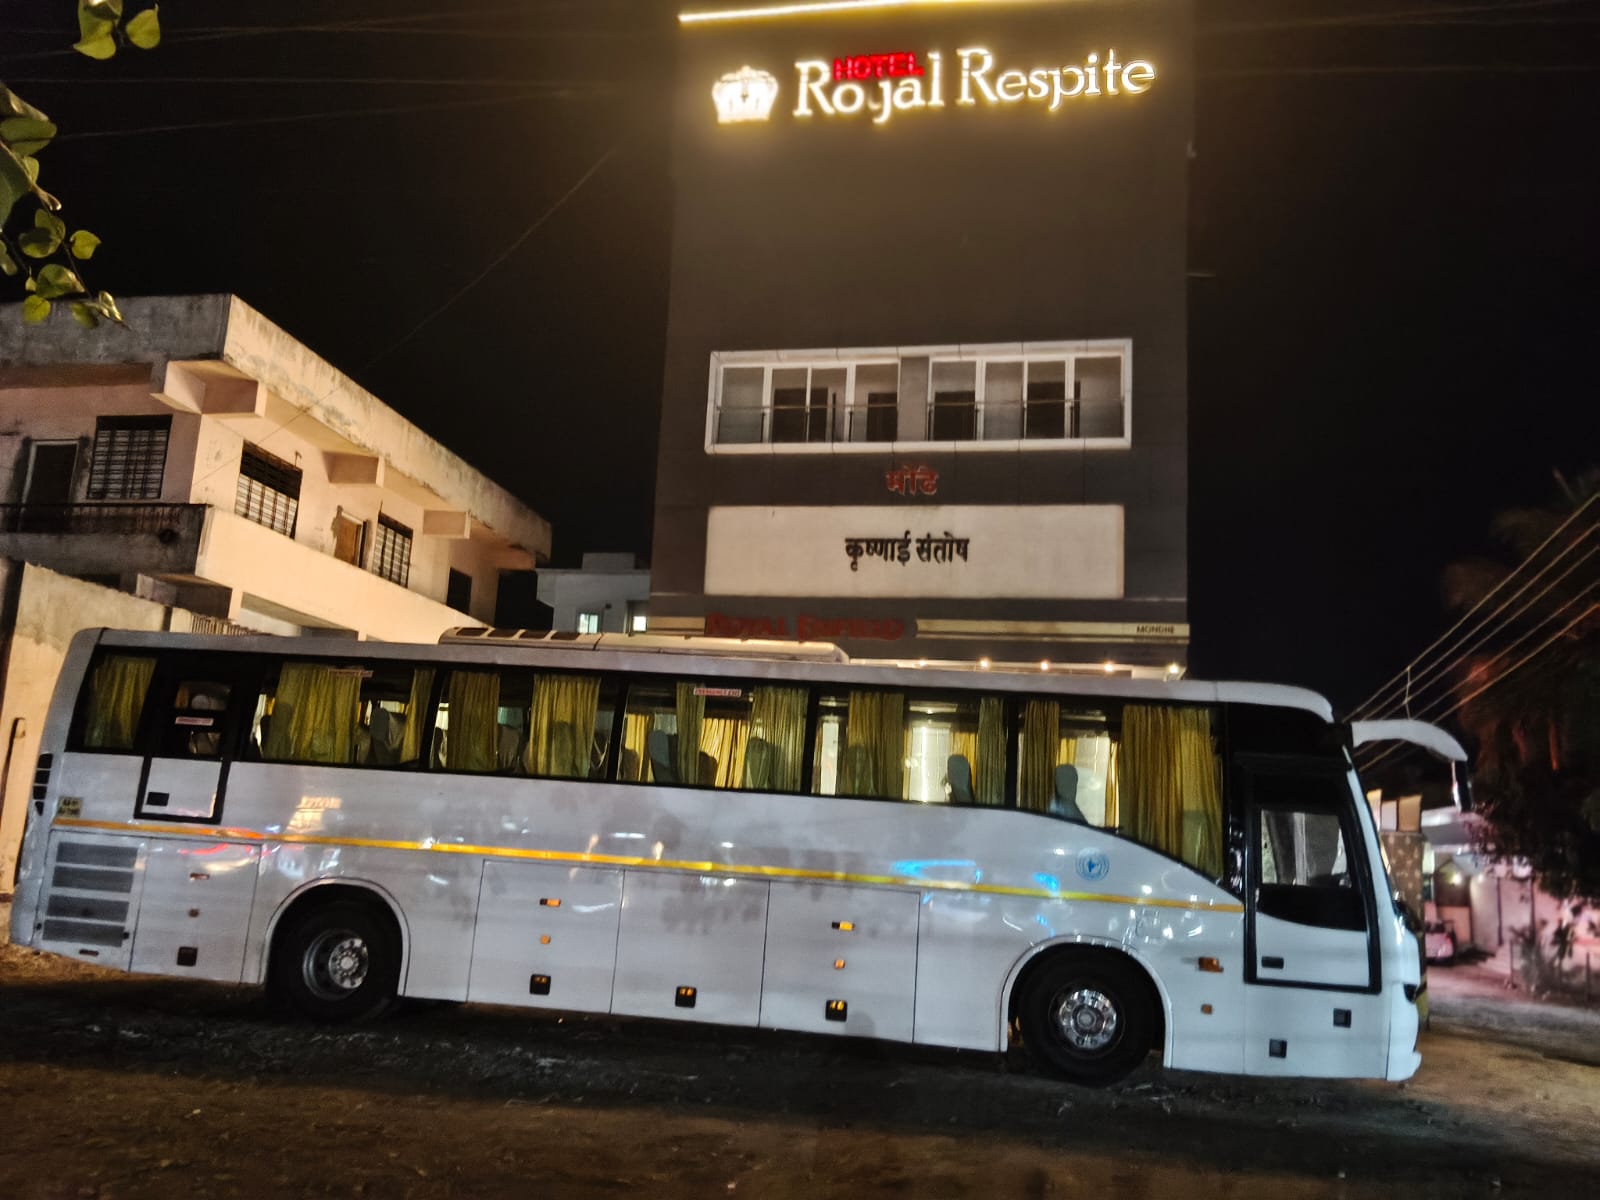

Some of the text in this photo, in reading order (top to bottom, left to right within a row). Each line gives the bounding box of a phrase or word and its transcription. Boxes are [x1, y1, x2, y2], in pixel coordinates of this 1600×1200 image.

[792, 46, 1157, 124] Royal Respite
[834, 51, 925, 80] HOTEL
[844, 530, 970, 572] कृष्णाई संतोष
